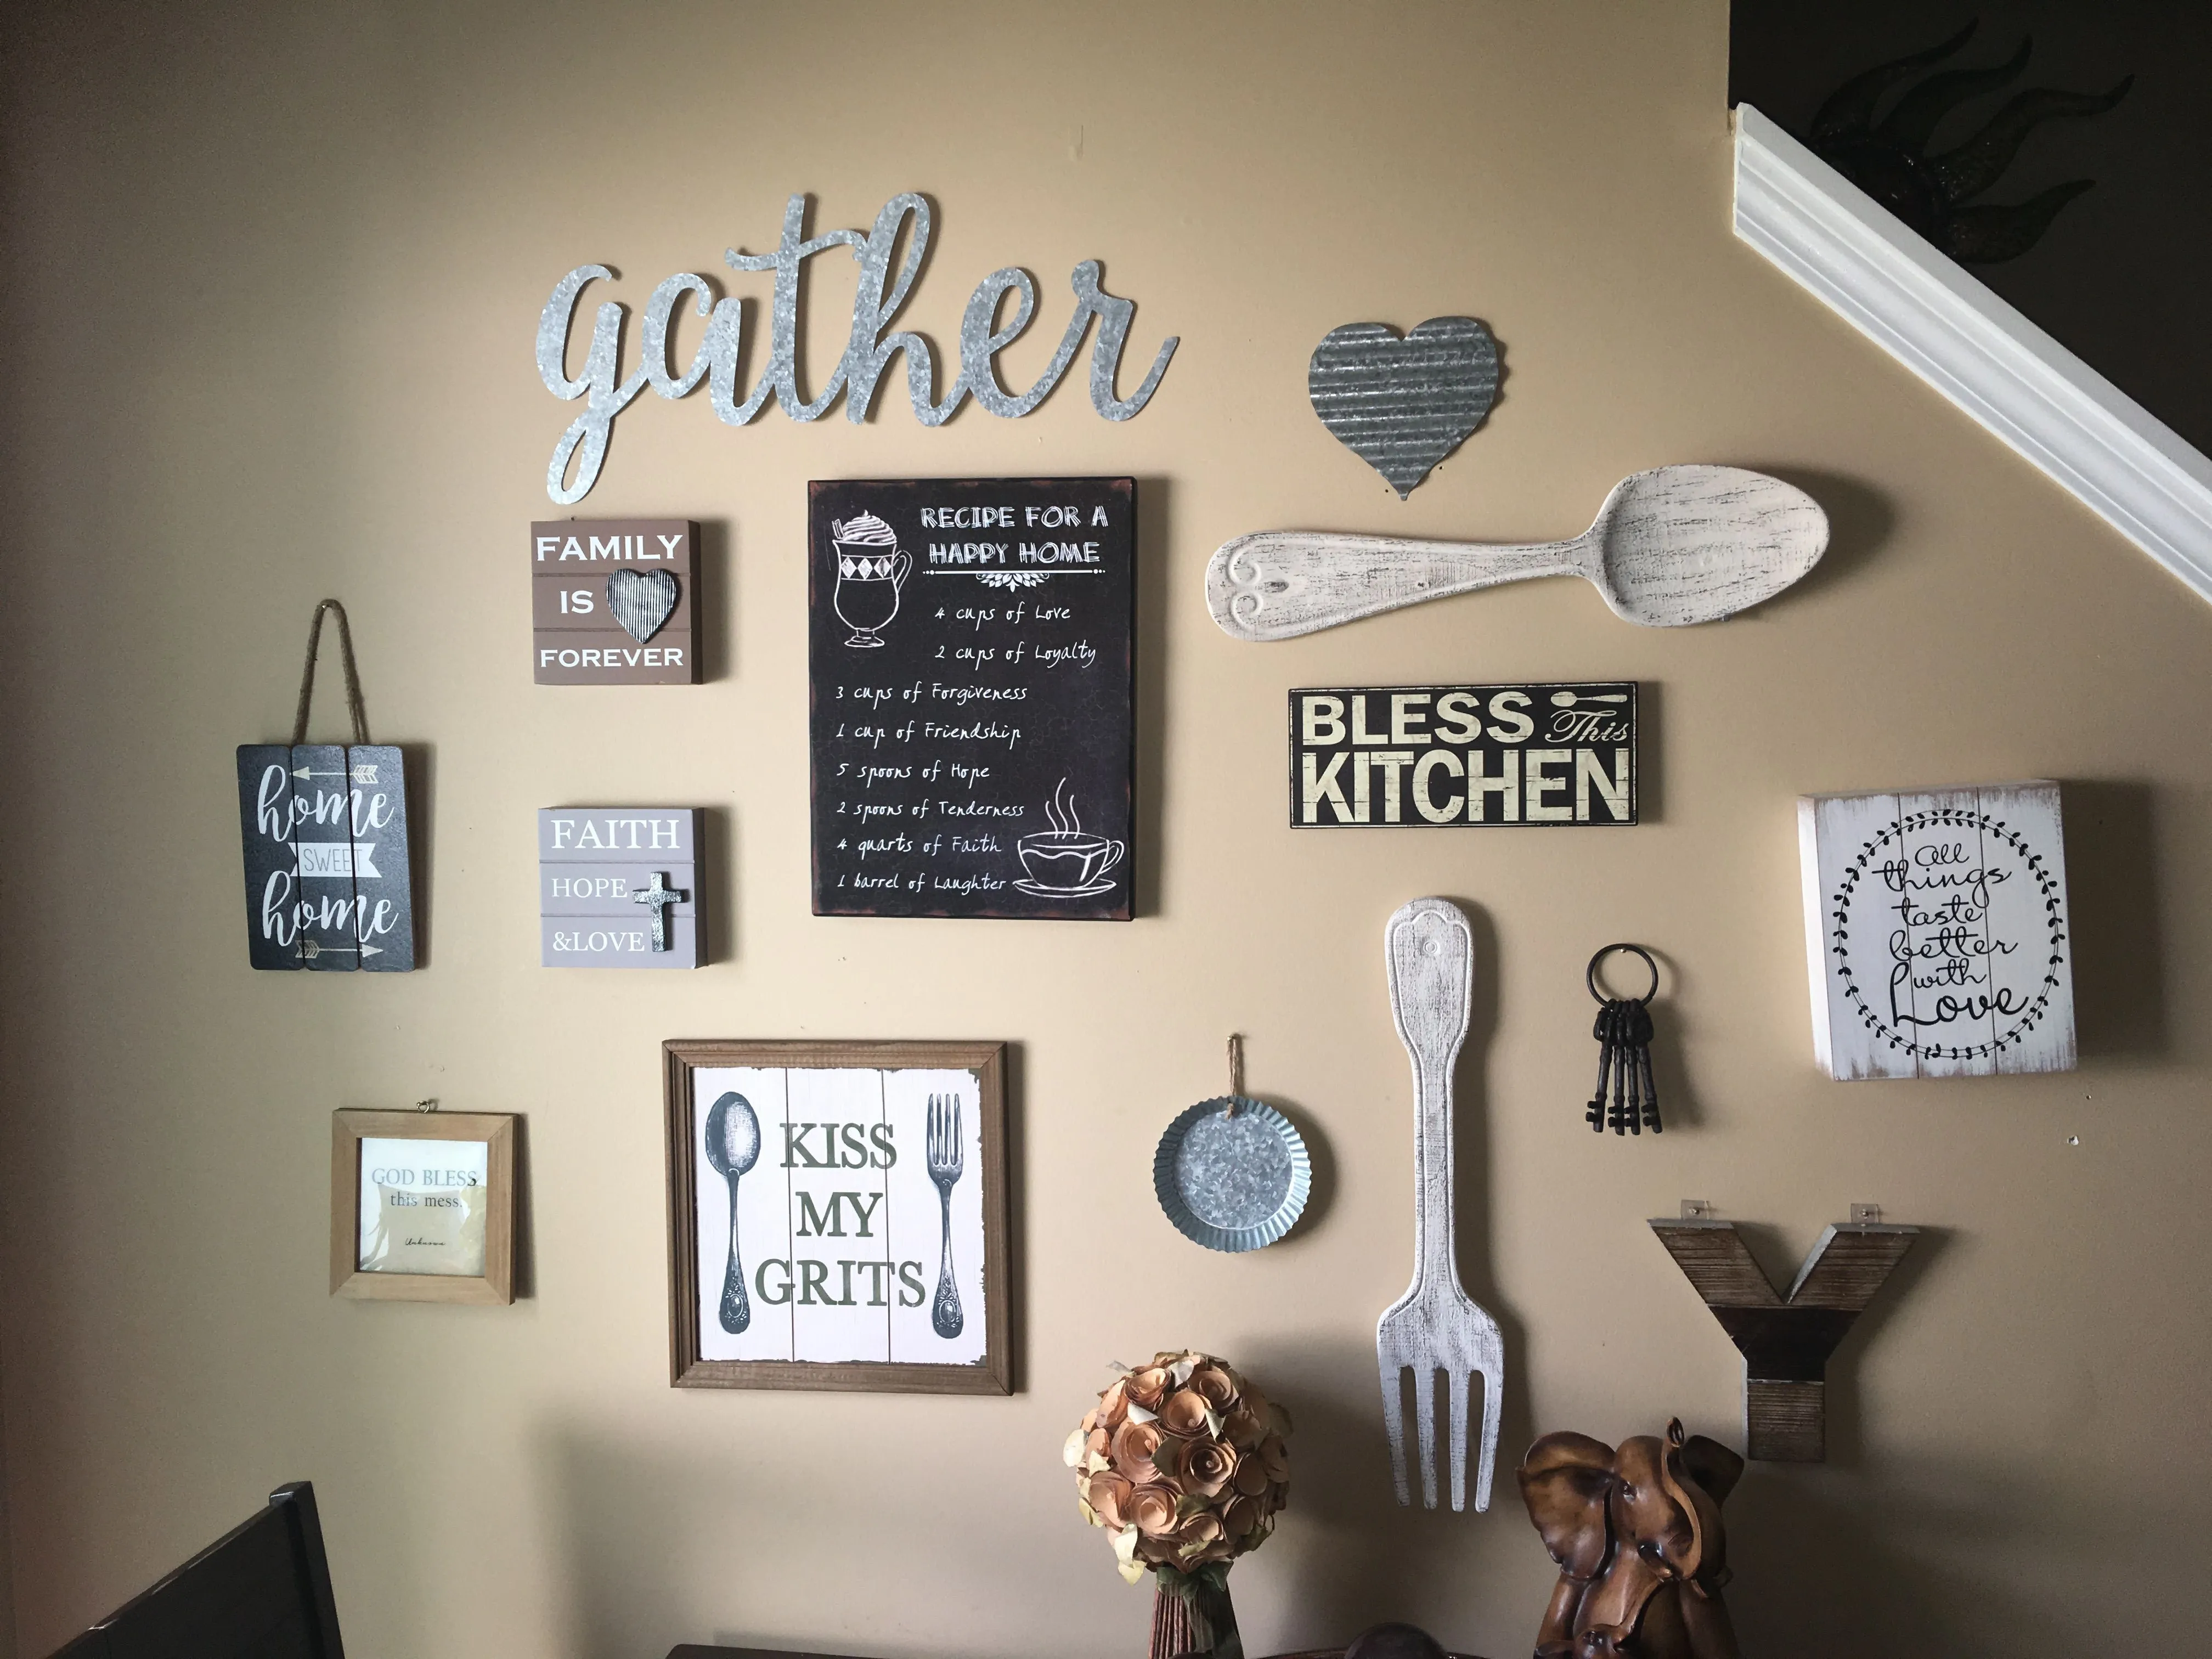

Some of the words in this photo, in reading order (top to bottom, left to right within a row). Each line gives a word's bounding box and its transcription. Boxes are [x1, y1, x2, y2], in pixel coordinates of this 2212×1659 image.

[536, 193, 1180, 504] gather
[921, 506, 1015, 528] RECIPE
[1025, 506, 1081, 528] FOR
[1092, 505, 1108, 527] A
[536, 535, 683, 561] FAMILY
[929, 543, 1008, 564] HAPPY
[1019, 542, 1099, 563] HOME
[560, 590, 594, 614] IS
[935, 607, 945, 619] 4
[956, 608, 995, 630] cups
[1007, 601, 1025, 623] of
[1036, 606, 1071, 619] Love
[540, 648, 684, 668] FOREVER
[935, 646, 945, 659] 2
[956, 647, 995, 670] cups
[1006, 641, 1025, 663] of
[1036, 640, 1096, 668] Loyalty
[836, 686, 843, 699] 3
[854, 687, 892, 710] cups
[904, 681, 922, 703] of
[933, 683, 1027, 706] Forgiveness
[1302, 691, 1534, 746] BLESS
[1544, 709, 1629, 743] This
[836, 724, 844, 737] 1
[855, 726, 885, 749] cup
[896, 720, 915, 742] of
[926, 721, 1021, 749] Friendship
[837, 763, 849, 776] 5
[857, 766, 912, 788] spoons
[922, 759, 941, 781] of
[951, 764, 990, 788] Hope
[1302, 748, 1629, 823] KITCHEN
[258, 765, 394, 842] home
[837, 802, 846, 814] 2
[854, 803, 902, 824] spoons
[912, 799, 929, 820] of
[939, 801, 1023, 816] Tenderness
[551, 820, 680, 849] FAITH
[837, 837, 847, 850] 4
[859, 832, 912, 860] quarts
[923, 834, 942, 856] of
[952, 837, 1002, 853] Faith
[303, 849, 363, 872] SWEET
[551, 878, 628, 898] HOPE
[837, 874, 845, 888] 1
[854, 874, 899, 888] barrel
[909, 873, 926, 894] of
[935, 873, 1006, 895] Laughter
[1872, 859, 2012, 909] things
[262, 871, 399, 947] home
[1891, 894, 1983, 926] taste
[552, 932, 645, 951] &LOVE
[1889, 926, 2018, 961] better
[1914, 958, 1987, 989] with
[1890, 962, 2029, 1028] Love
[780, 1122, 898, 1170] KISS
[372, 1168, 414, 1186] GOD
[423, 1170, 477, 1187] BLESS
[391, 1192, 417, 1206] this
[424, 1196, 462, 1207] mess.
[795, 1191, 883, 1238] MY
[405, 1238, 446, 1246] Unknown
[755, 1259, 926, 1308] GRITS
[1646, 1218, 1920, 1463] Y
